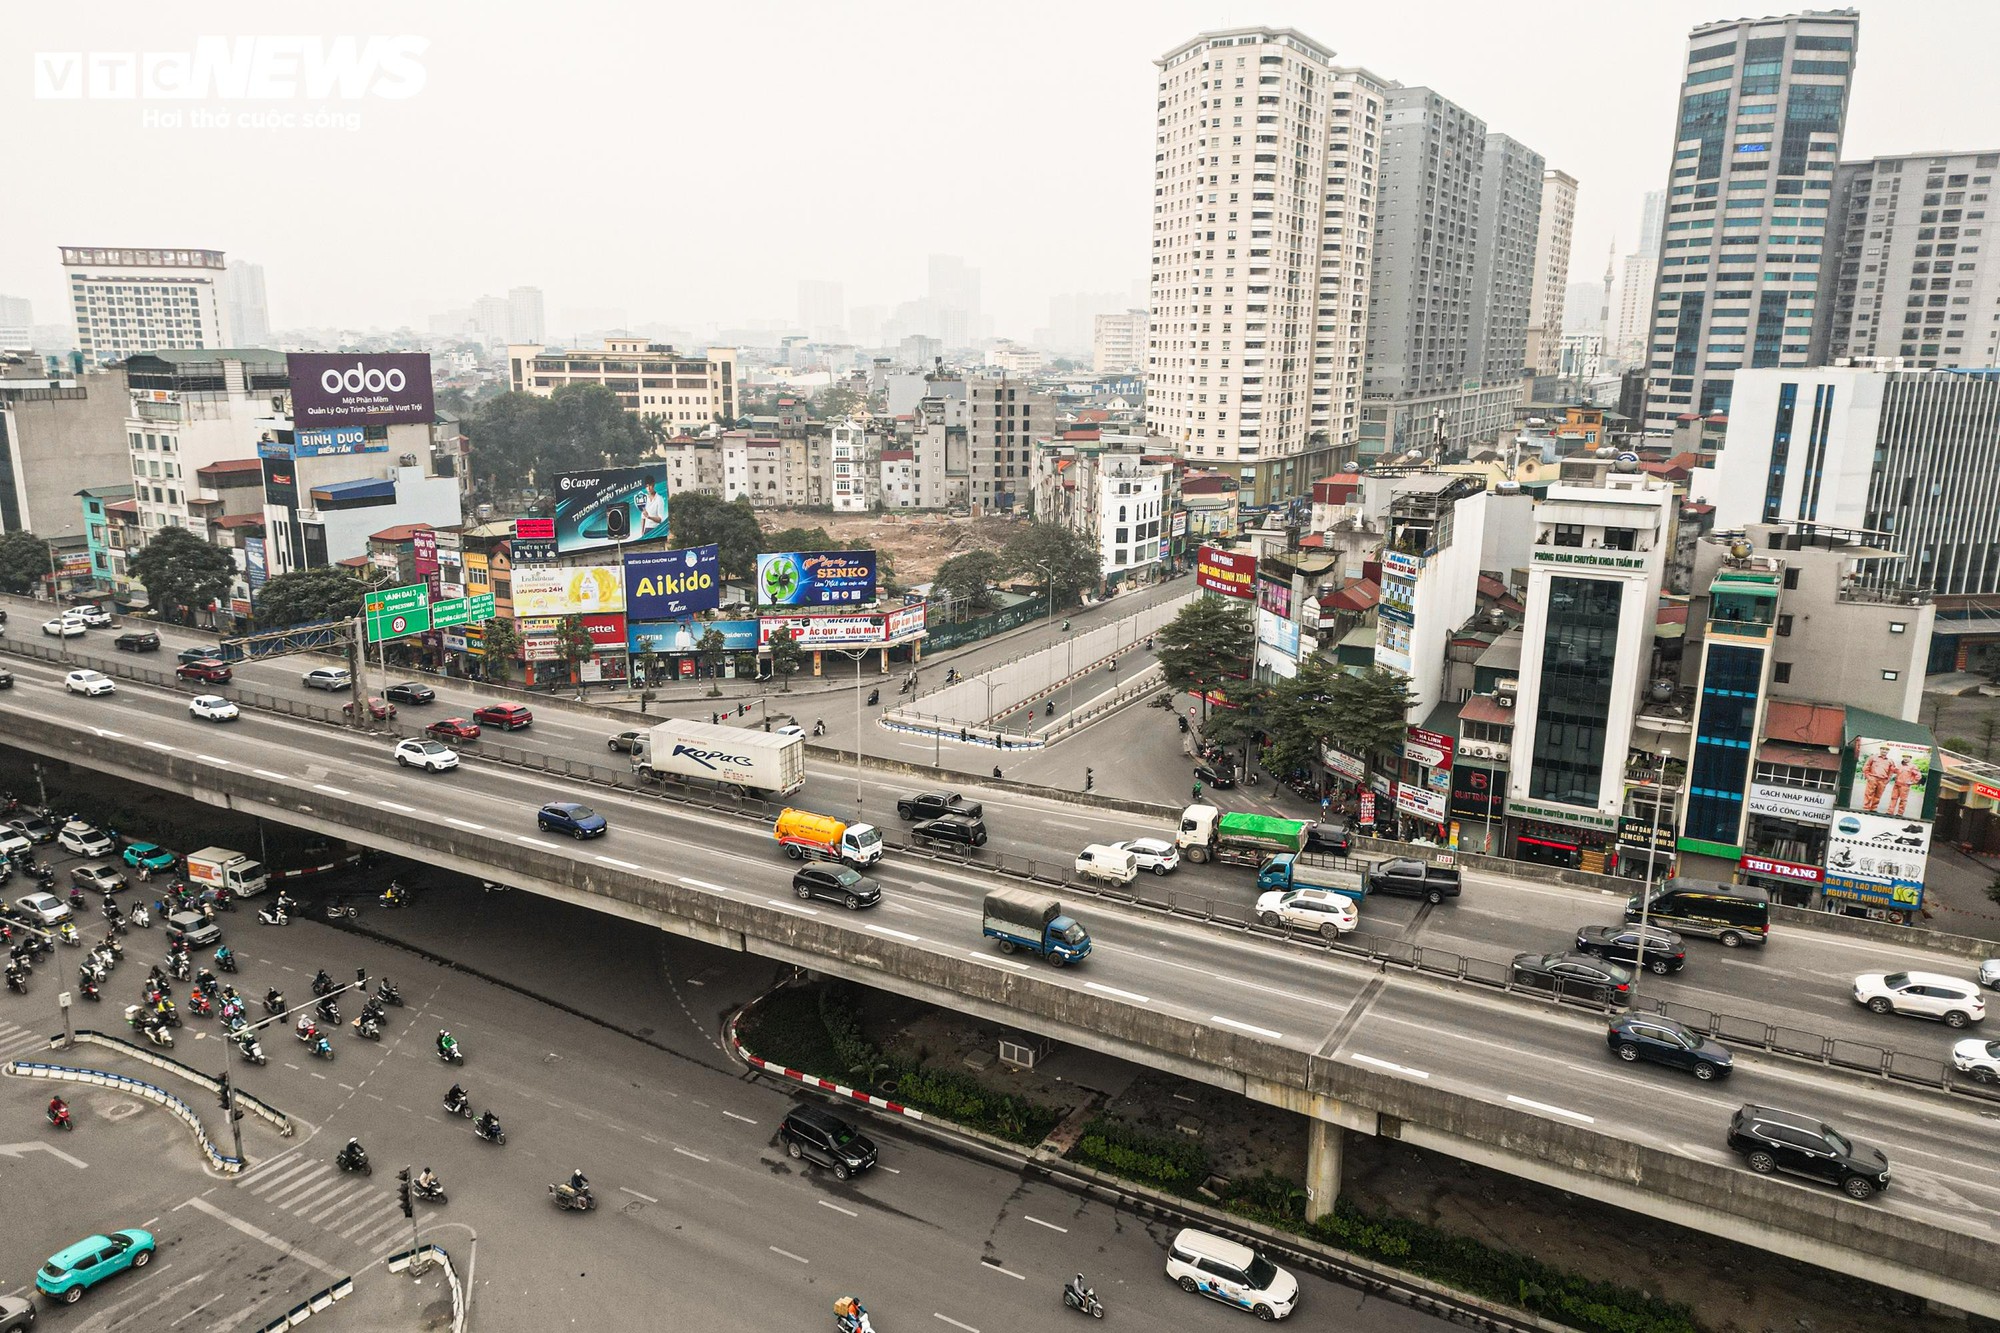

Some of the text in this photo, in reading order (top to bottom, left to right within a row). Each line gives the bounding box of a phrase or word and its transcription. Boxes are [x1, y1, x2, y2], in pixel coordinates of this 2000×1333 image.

[321, 362, 406, 394] odoo
[571, 478, 600, 490] Casper
[1534, 550, 1554, 562] PHÒNG
[1555, 552, 1572, 563] KHÁM
[1574, 554, 1597, 565] CHUYÊN
[1598, 557, 1614, 566] KHOA
[817, 566, 868, 578] SENKO
[636, 570, 711, 597] Aikido
[395, 621, 403, 629] 80
[1407, 752, 1431, 763] CADIVI
[1760, 789, 1780, 799] GẠCH
[1748, 860, 1817, 879] THU TRANG
[1856, 882, 1869, 890] LAO
[1861, 893, 1889, 905] NHUNG
